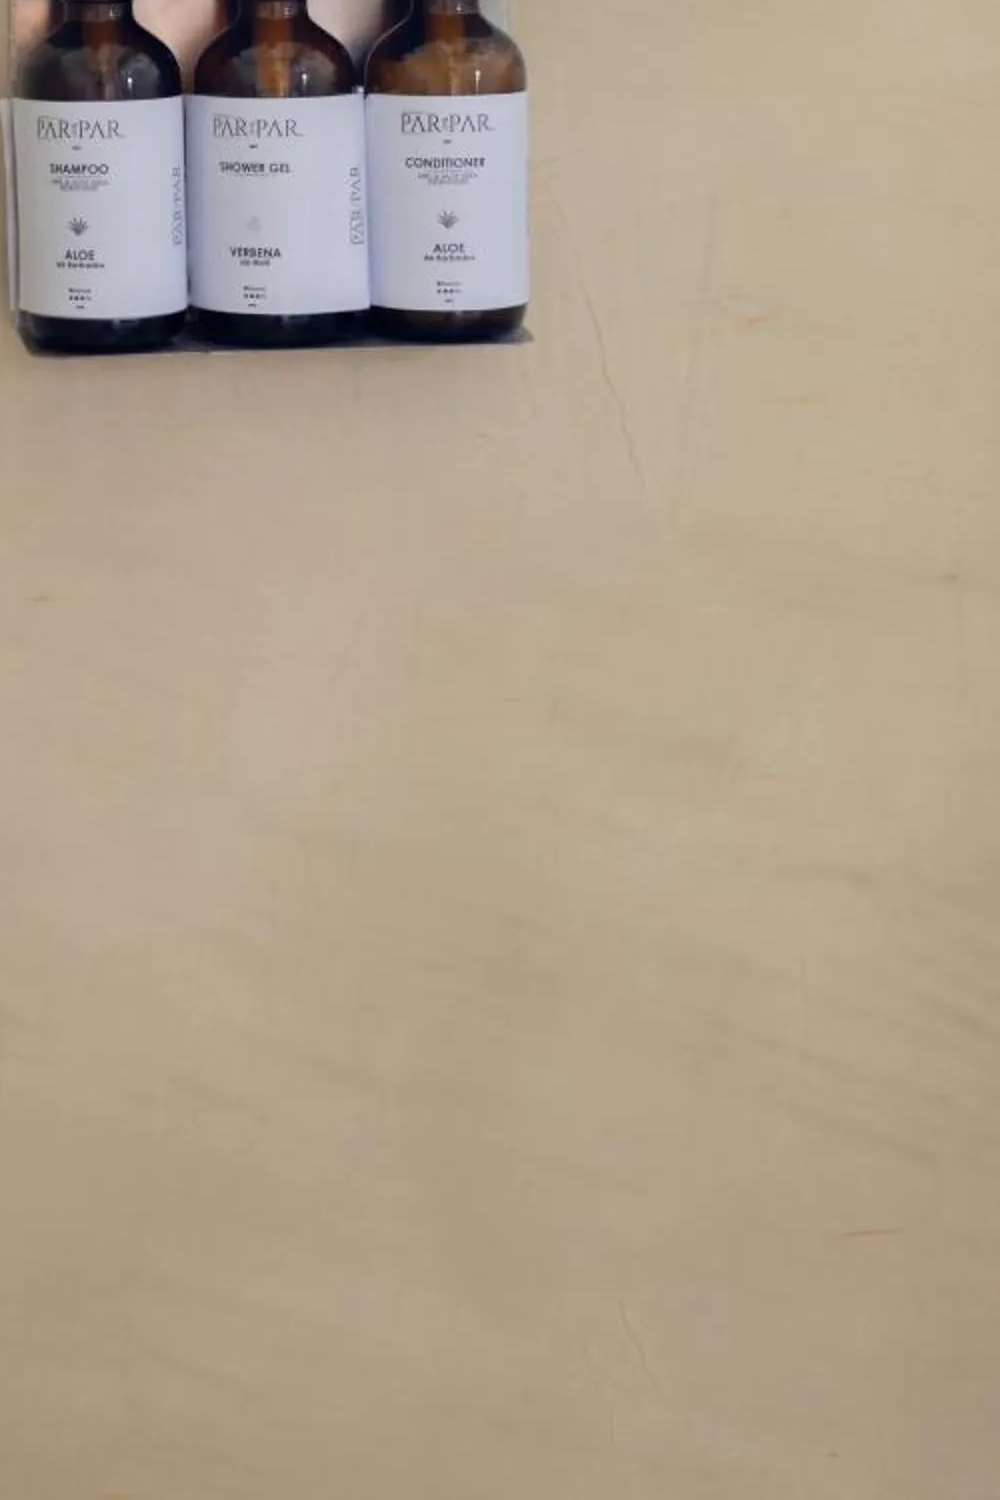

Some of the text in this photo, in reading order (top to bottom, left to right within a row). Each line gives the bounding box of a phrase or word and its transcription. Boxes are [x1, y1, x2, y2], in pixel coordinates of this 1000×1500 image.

[219, 162, 291, 173] SHOWER GEL
[405, 157, 486, 169] CONDITIONER
[49, 163, 109, 175] SHAMPOO
[230, 247, 281, 257] VERBENA
[433, 243, 465, 253] ALOE
[65, 249, 95, 260] ALOE
